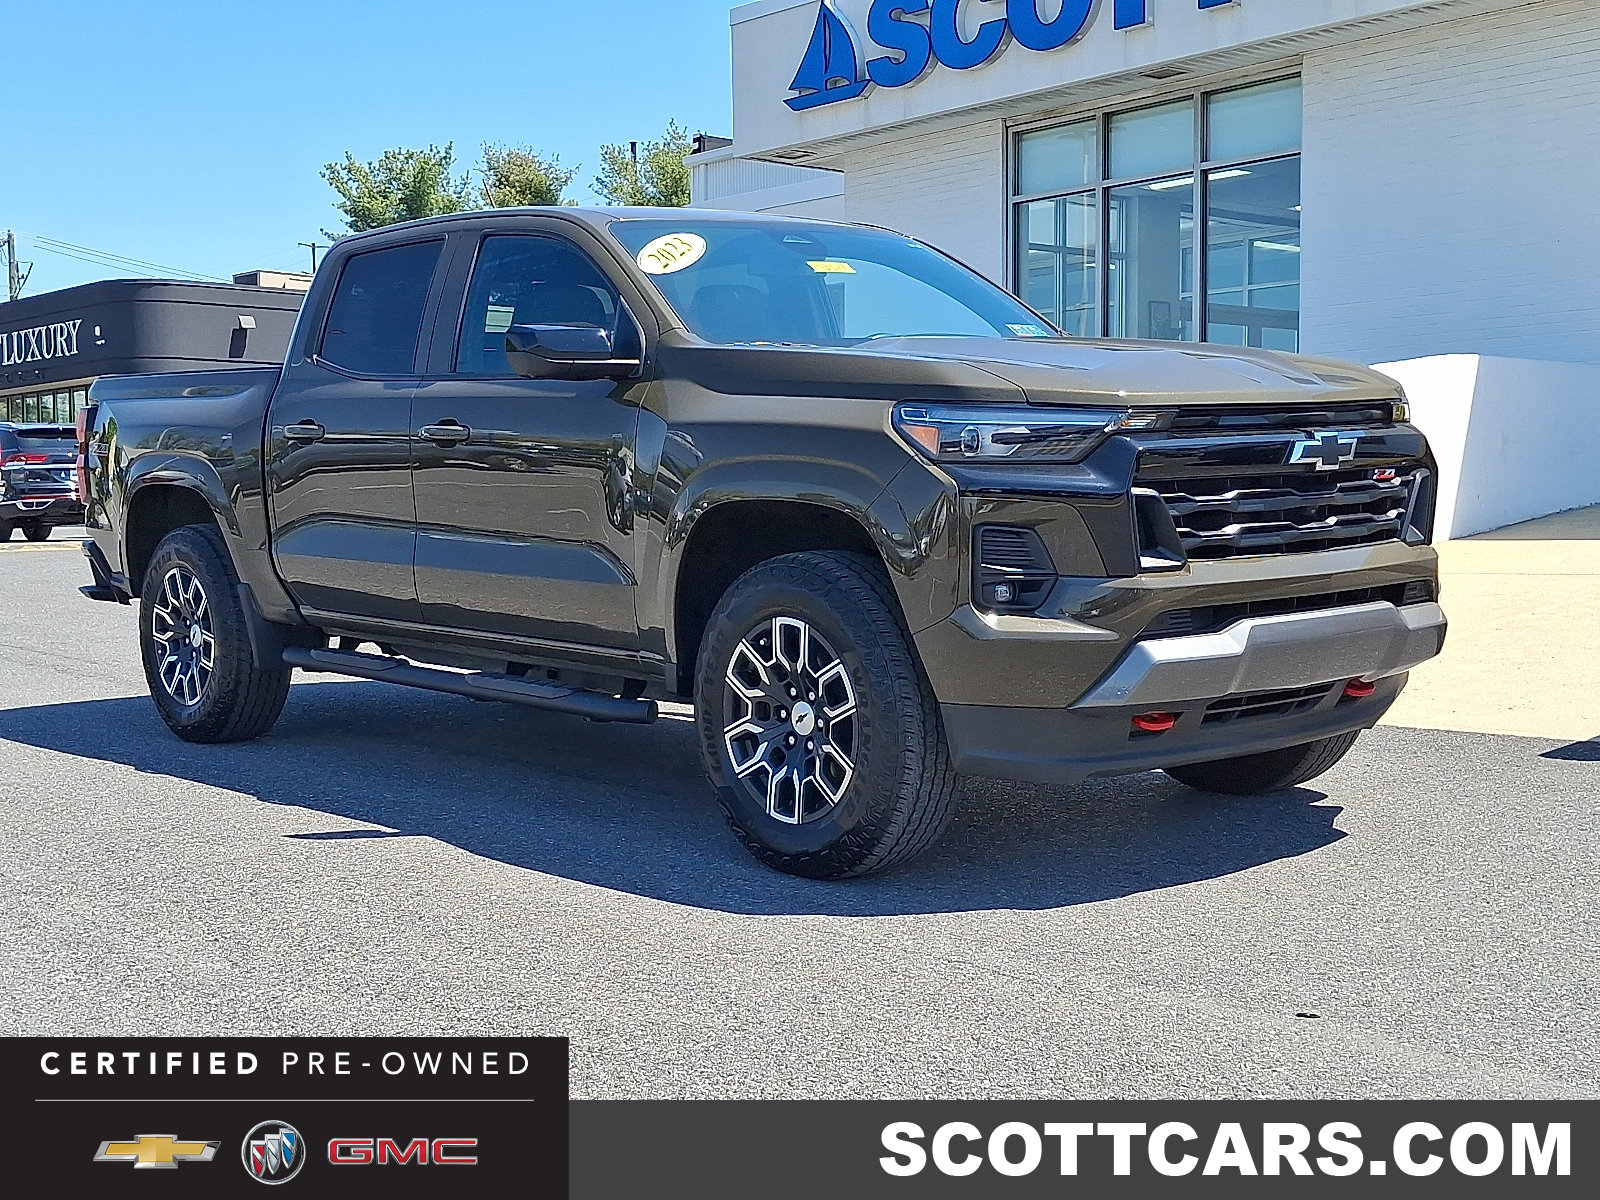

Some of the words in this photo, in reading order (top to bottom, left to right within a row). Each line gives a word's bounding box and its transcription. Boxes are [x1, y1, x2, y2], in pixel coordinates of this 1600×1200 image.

[866, 0, 1232, 89] SCO
[648, 238, 694, 269] 2023
[2, 319, 83, 366] LUXURY
